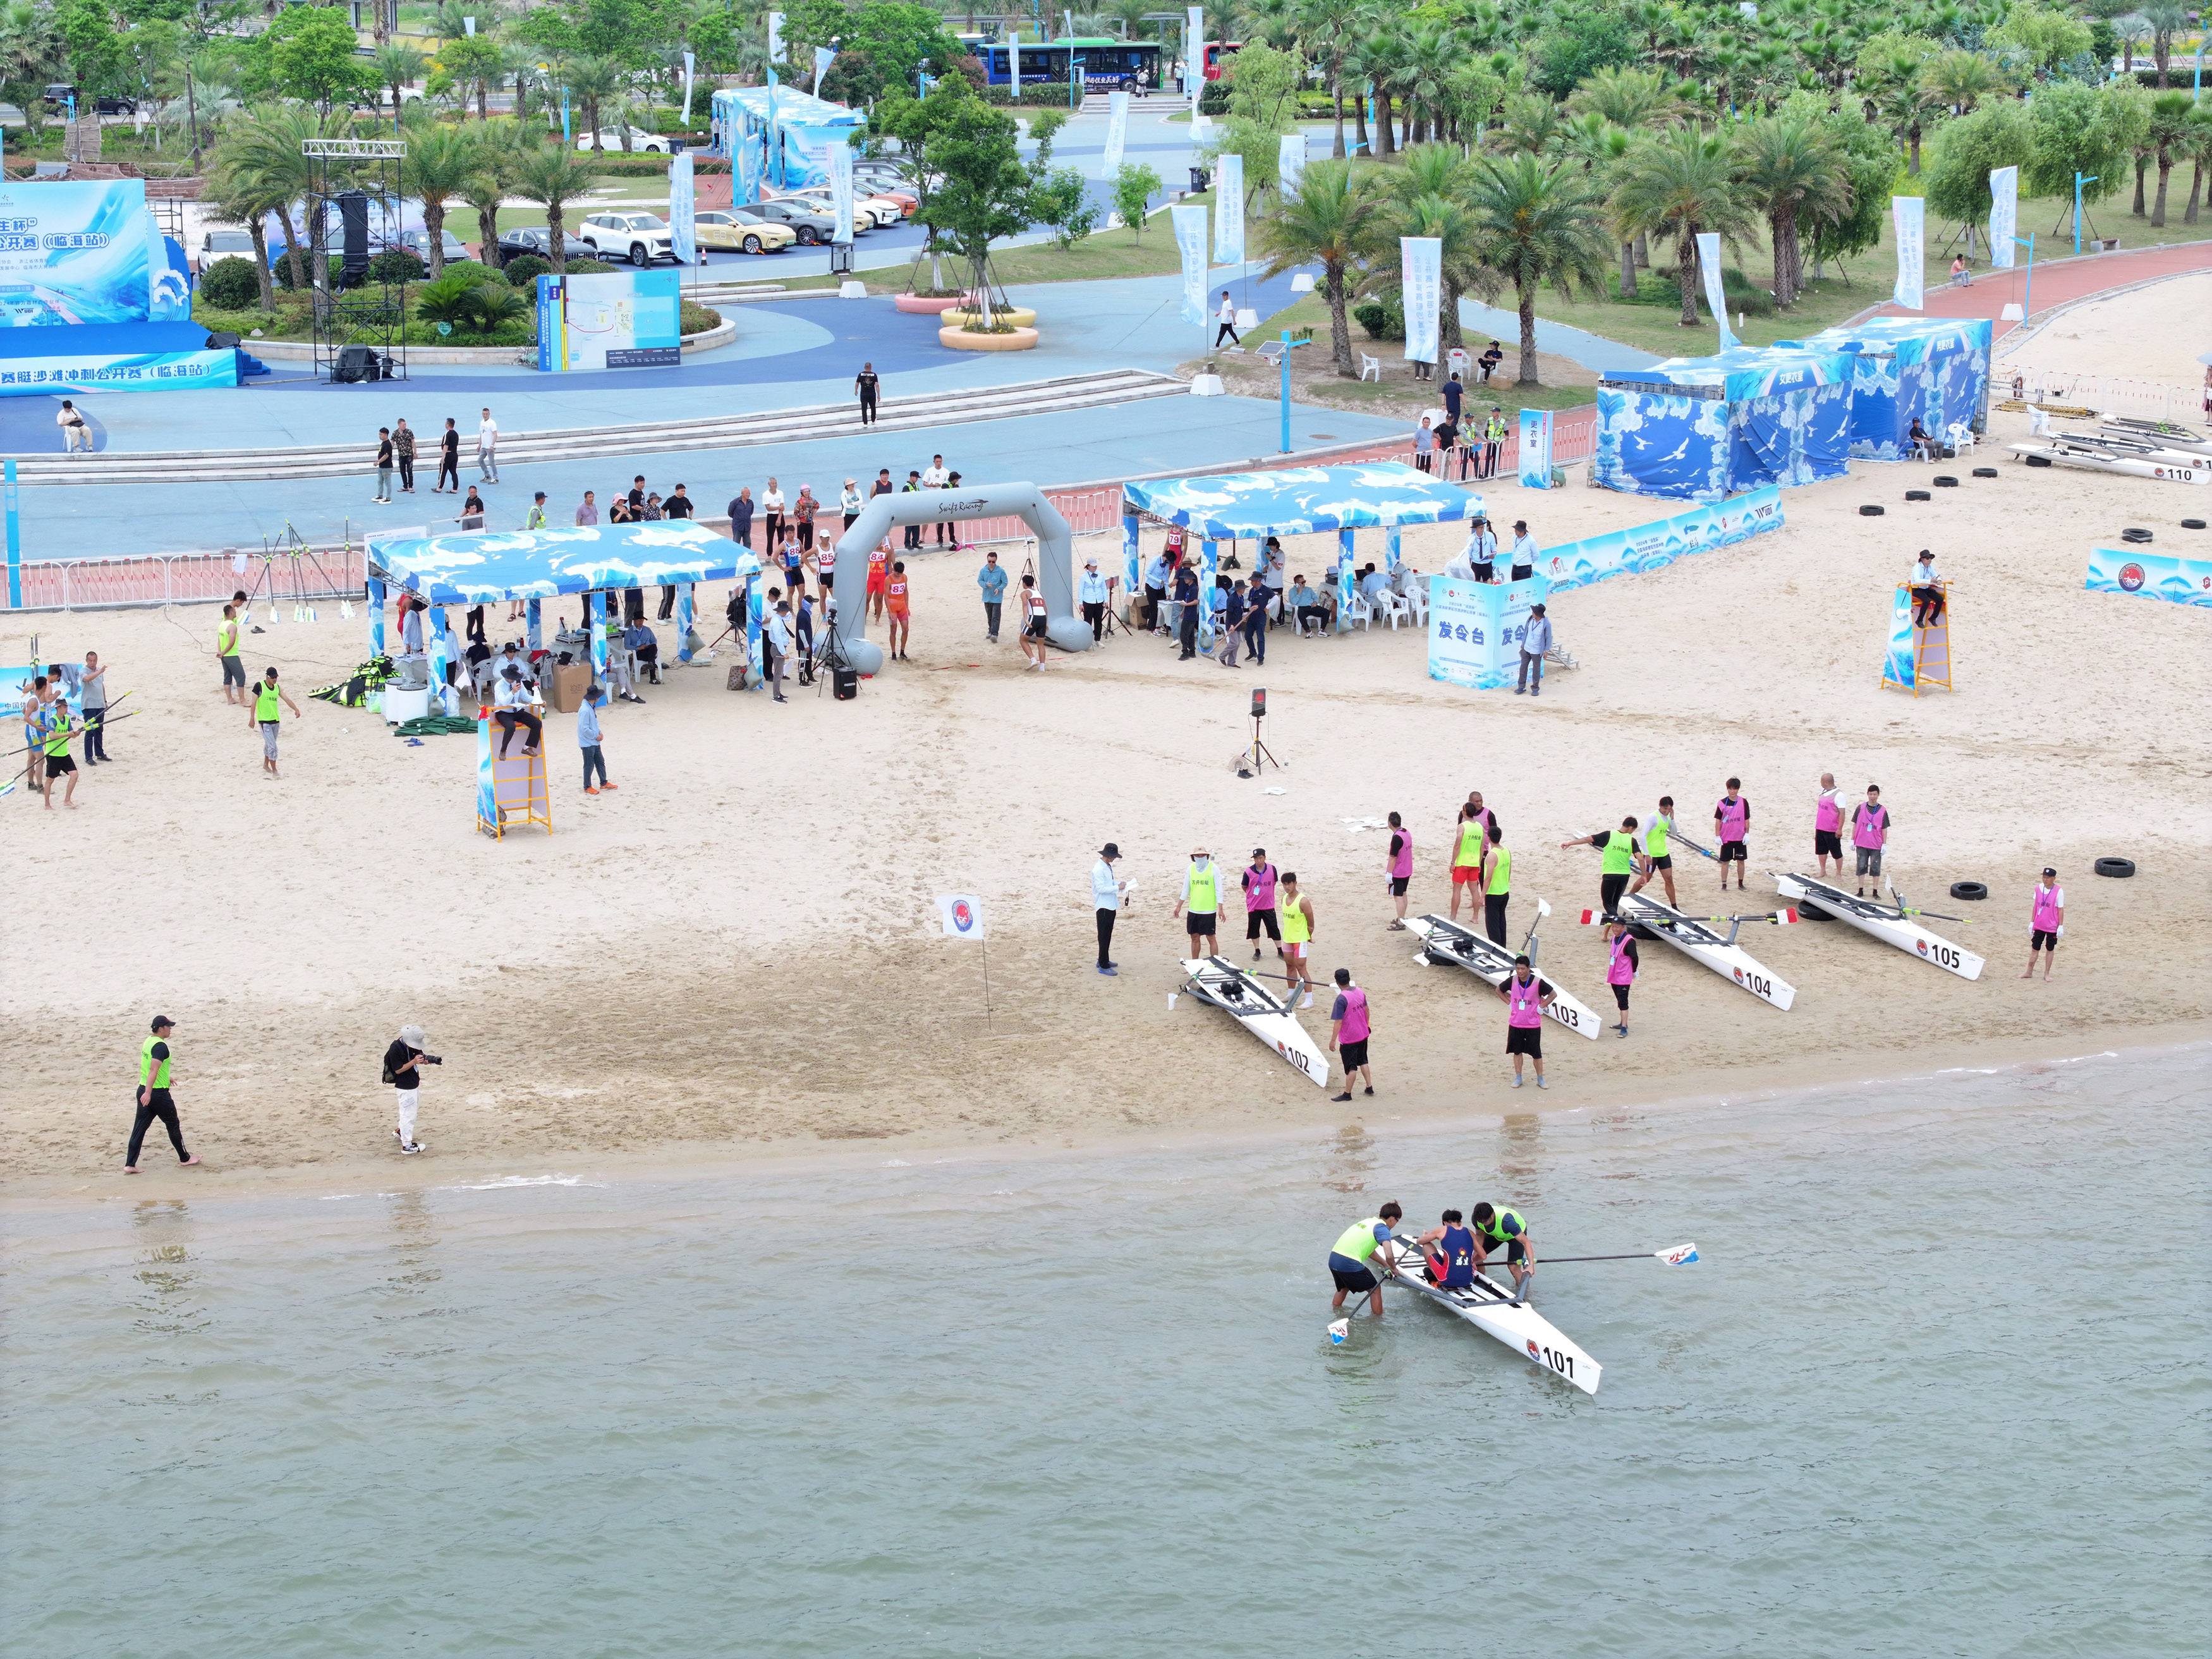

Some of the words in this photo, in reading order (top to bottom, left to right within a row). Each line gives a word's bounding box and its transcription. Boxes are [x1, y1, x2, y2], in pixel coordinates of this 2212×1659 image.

[1936, 337, 1954, 352] 男更衣室
[1, 364, 210, 384] 赛艇沙滩冲刺公开赛（临海站）
[1779, 370, 1804, 386] 女更衣室
[2168, 469, 2192, 480] 110
[939, 502, 958, 514] Swift
[959, 502, 983, 512] Racing
[1170, 535, 1179, 544] 79
[790, 547, 799, 556] 88
[822, 553, 833, 561] 85
[871, 553, 884, 561] 84
[1438, 621, 1485, 646] 发令台
[1502, 625, 1525, 646] 发令
[1932, 944, 1960, 969] 105
[1746, 972, 1771, 998] 104
[1552, 1002, 1578, 1027] 103
[1288, 1047, 1310, 1074] 102
[1543, 1346, 1573, 1379] 101
